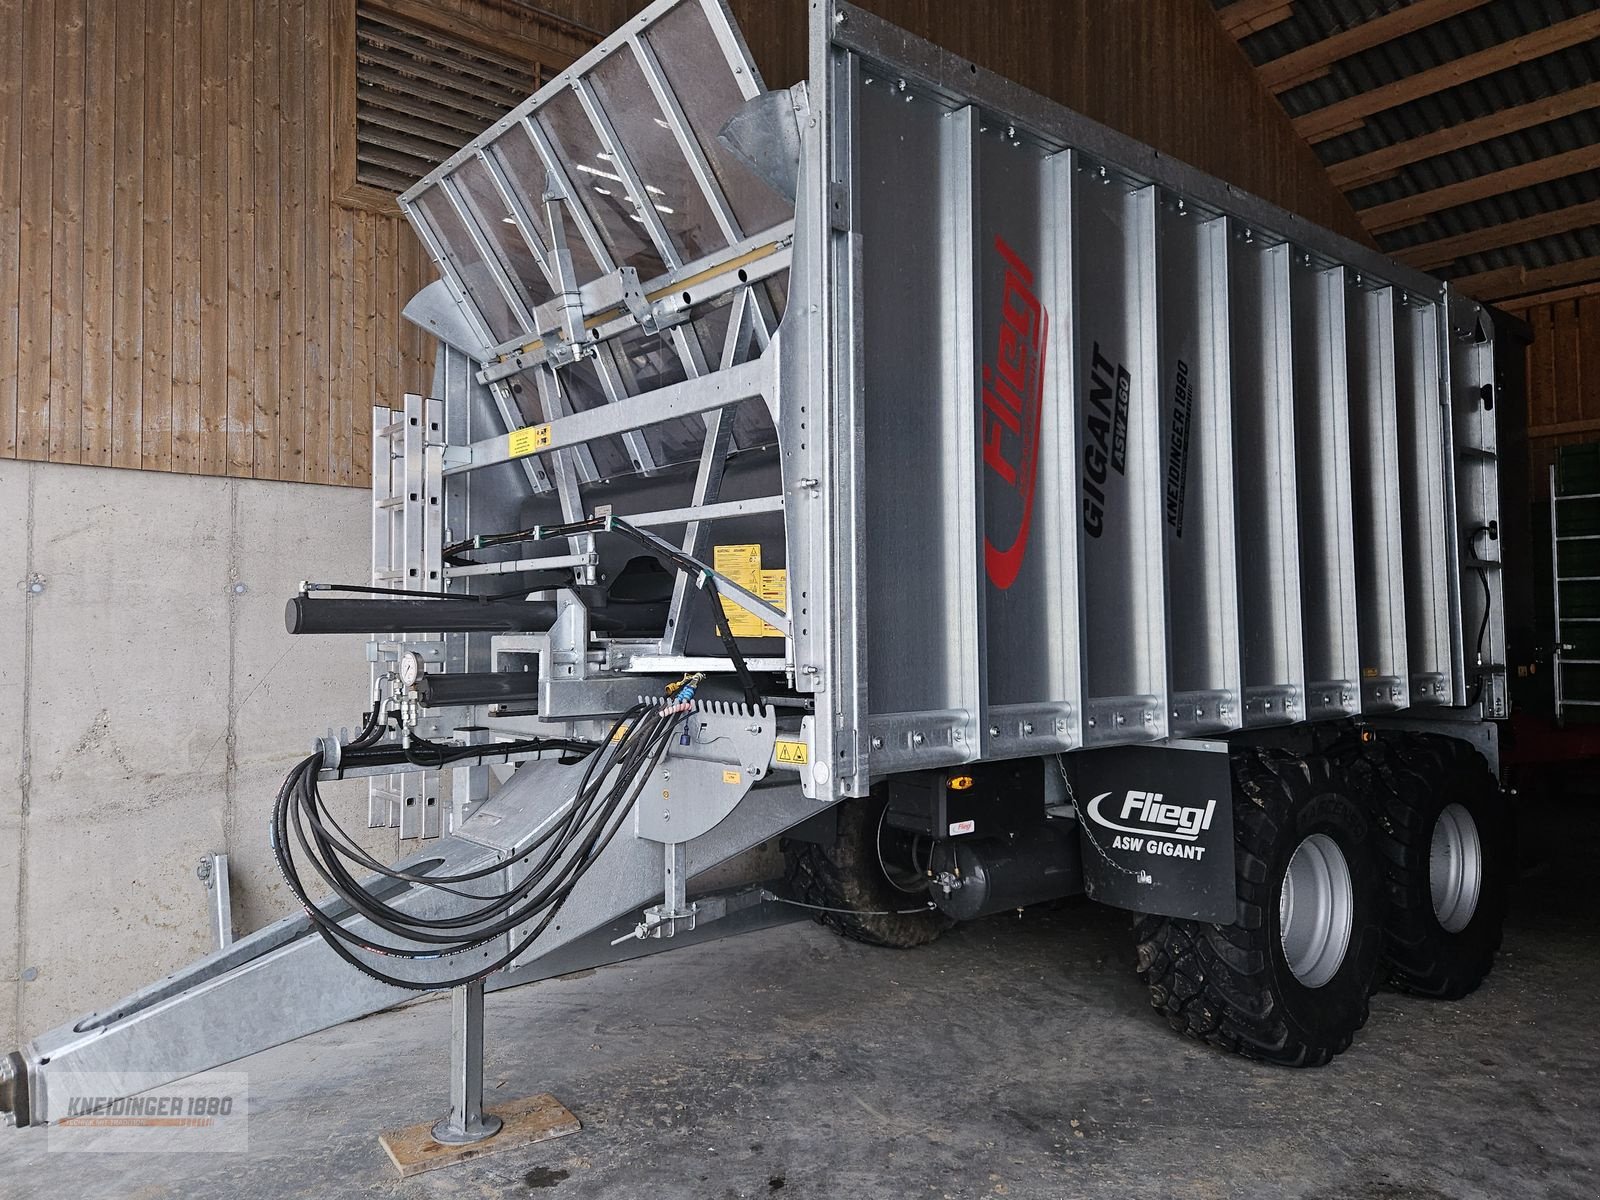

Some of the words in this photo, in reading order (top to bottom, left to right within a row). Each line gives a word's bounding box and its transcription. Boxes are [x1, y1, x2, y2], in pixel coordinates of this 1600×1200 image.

[982, 233, 1041, 484] Fliegl
[1175, 360, 1189, 405] 1880
[1117, 376, 1130, 416] 160
[1083, 342, 1115, 538] GIGANT
[1113, 415, 1128, 466] ASW
[1167, 410, 1186, 527] KNEIDINGER
[1120, 790, 1216, 835] Fliegl
[1112, 835, 1144, 850] ASW
[1146, 840, 1205, 861] GIGANT
